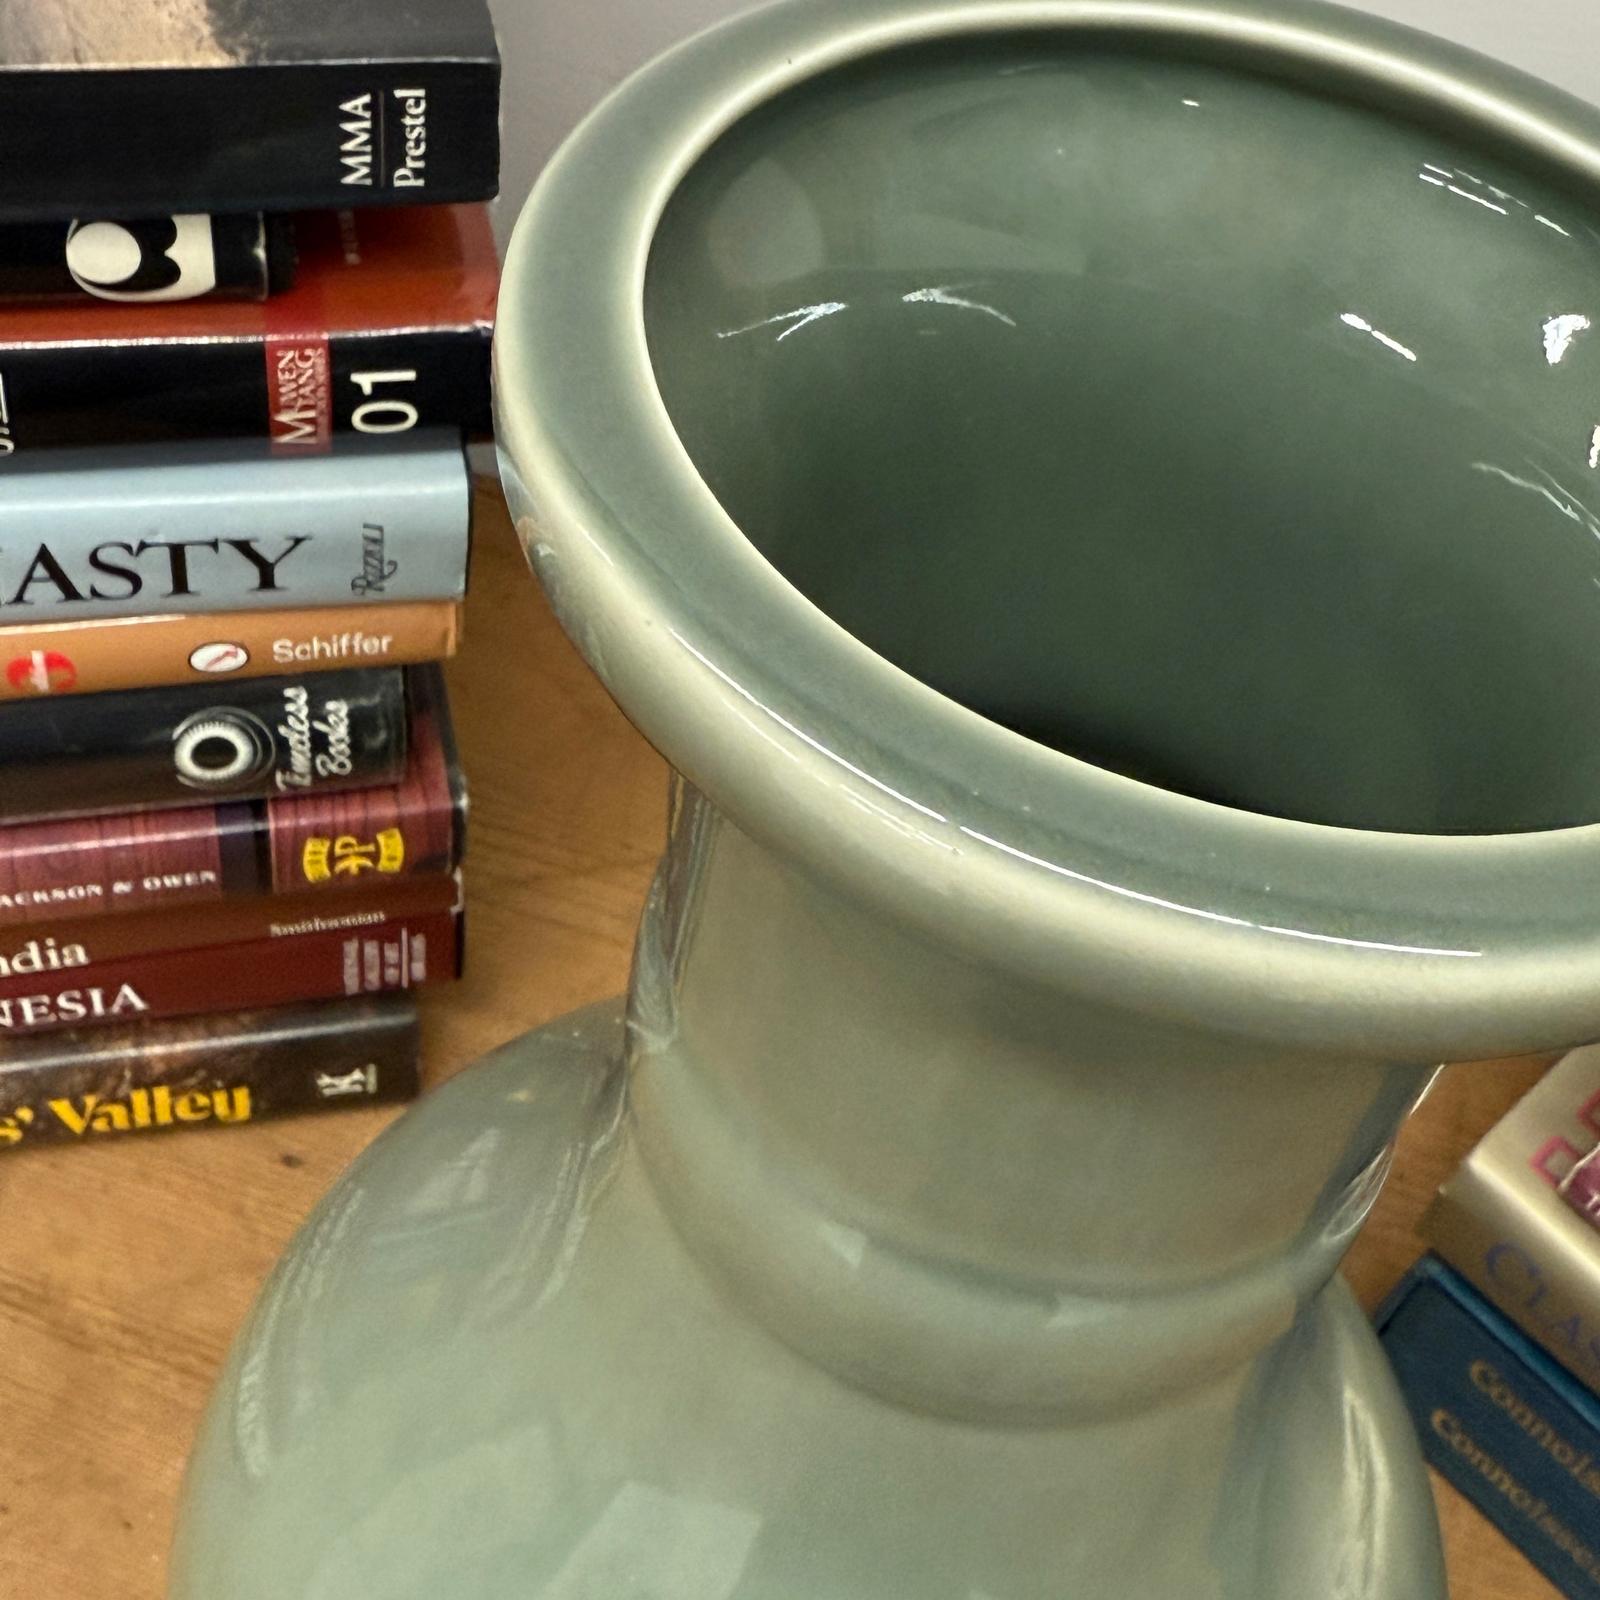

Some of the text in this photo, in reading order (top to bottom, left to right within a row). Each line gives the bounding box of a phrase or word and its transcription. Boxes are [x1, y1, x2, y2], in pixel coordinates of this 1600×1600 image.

[339, 92, 373, 186] MMA
[393, 88, 426, 188] Prestel
[350, 369, 418, 434] 01
[272, 633, 393, 663] Schiffer
[143, 870, 217, 891] OWEN
[50, 1085, 251, 1135] Valley
